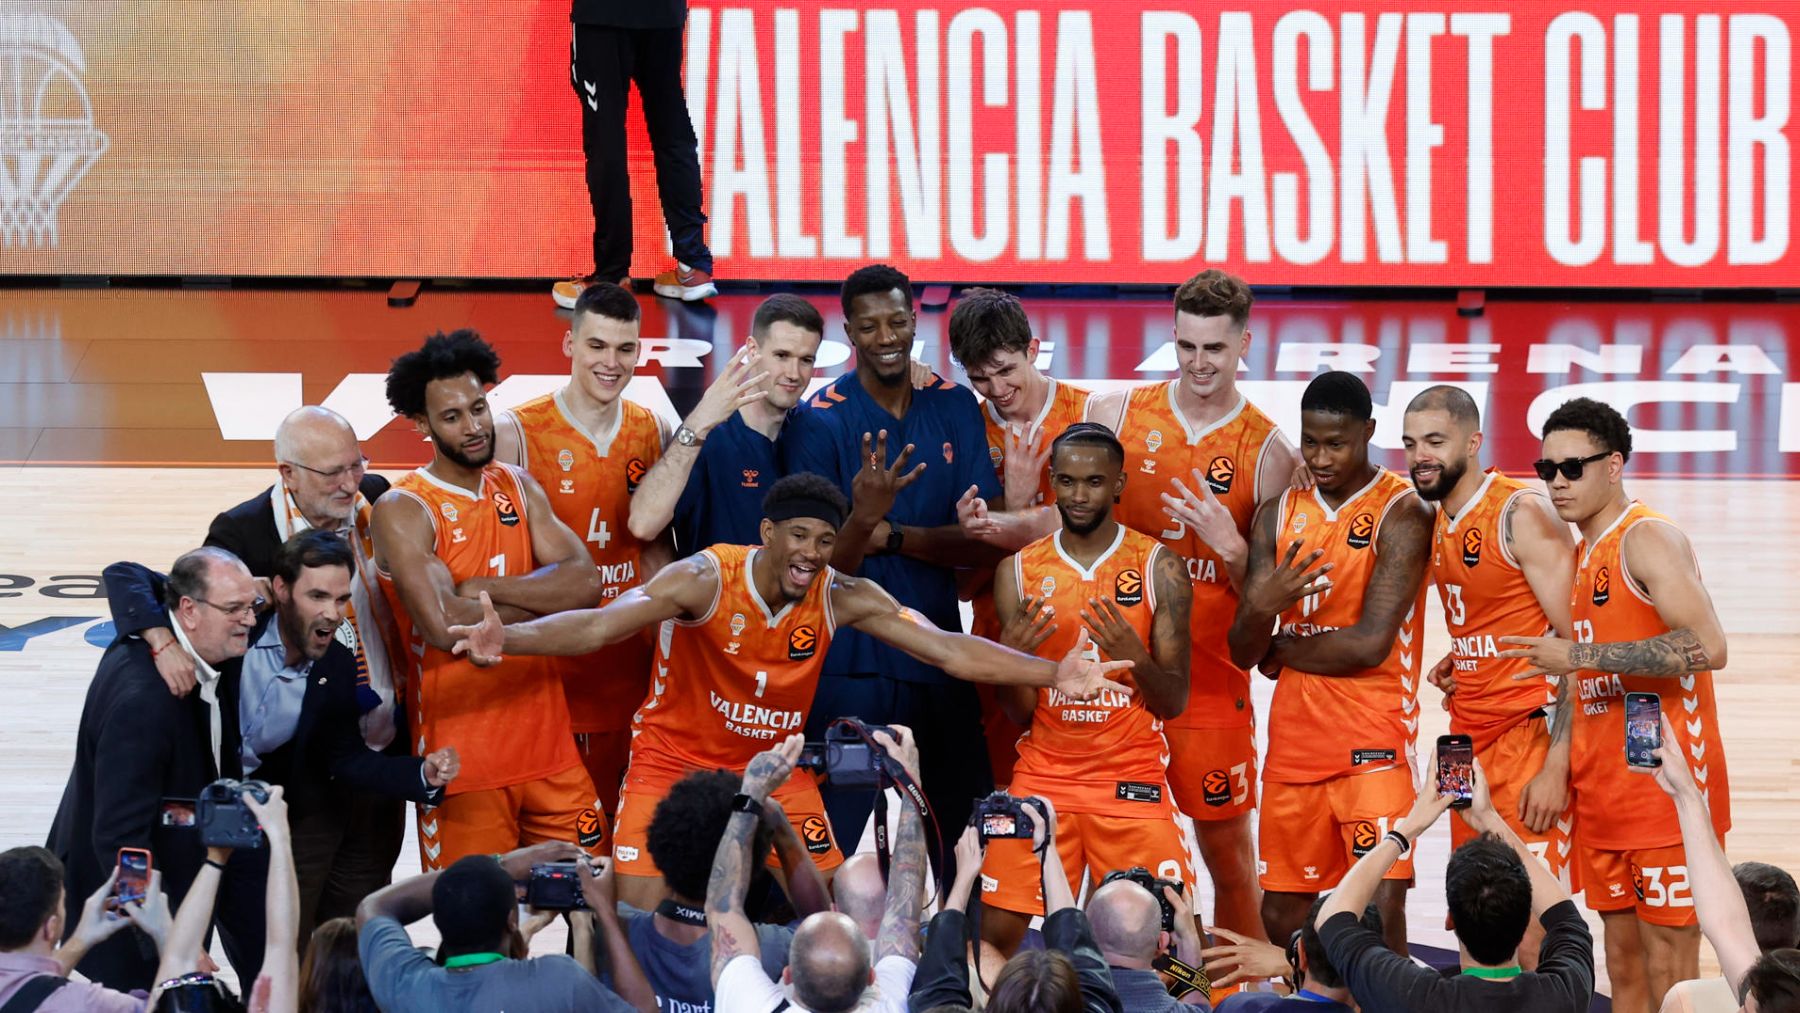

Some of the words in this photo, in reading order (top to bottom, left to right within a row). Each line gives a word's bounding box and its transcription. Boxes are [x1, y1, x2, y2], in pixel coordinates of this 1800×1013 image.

[1140, 10, 1511, 265] BASKET
[1543, 10, 1792, 268] CLUB
[587, 507, 611, 549] 4
[597, 561, 635, 584] NCIA
[755, 671, 768, 698] 1
[710, 690, 802, 731] VALENCIA
[1062, 710, 1111, 723] BASKET
[725, 720, 777, 741] BASKET
[907, 783, 928, 816] Canon
[1230, 761, 1249, 806] 3
[1642, 865, 1695, 908] 32
[1170, 964, 1192, 980] Nikon
